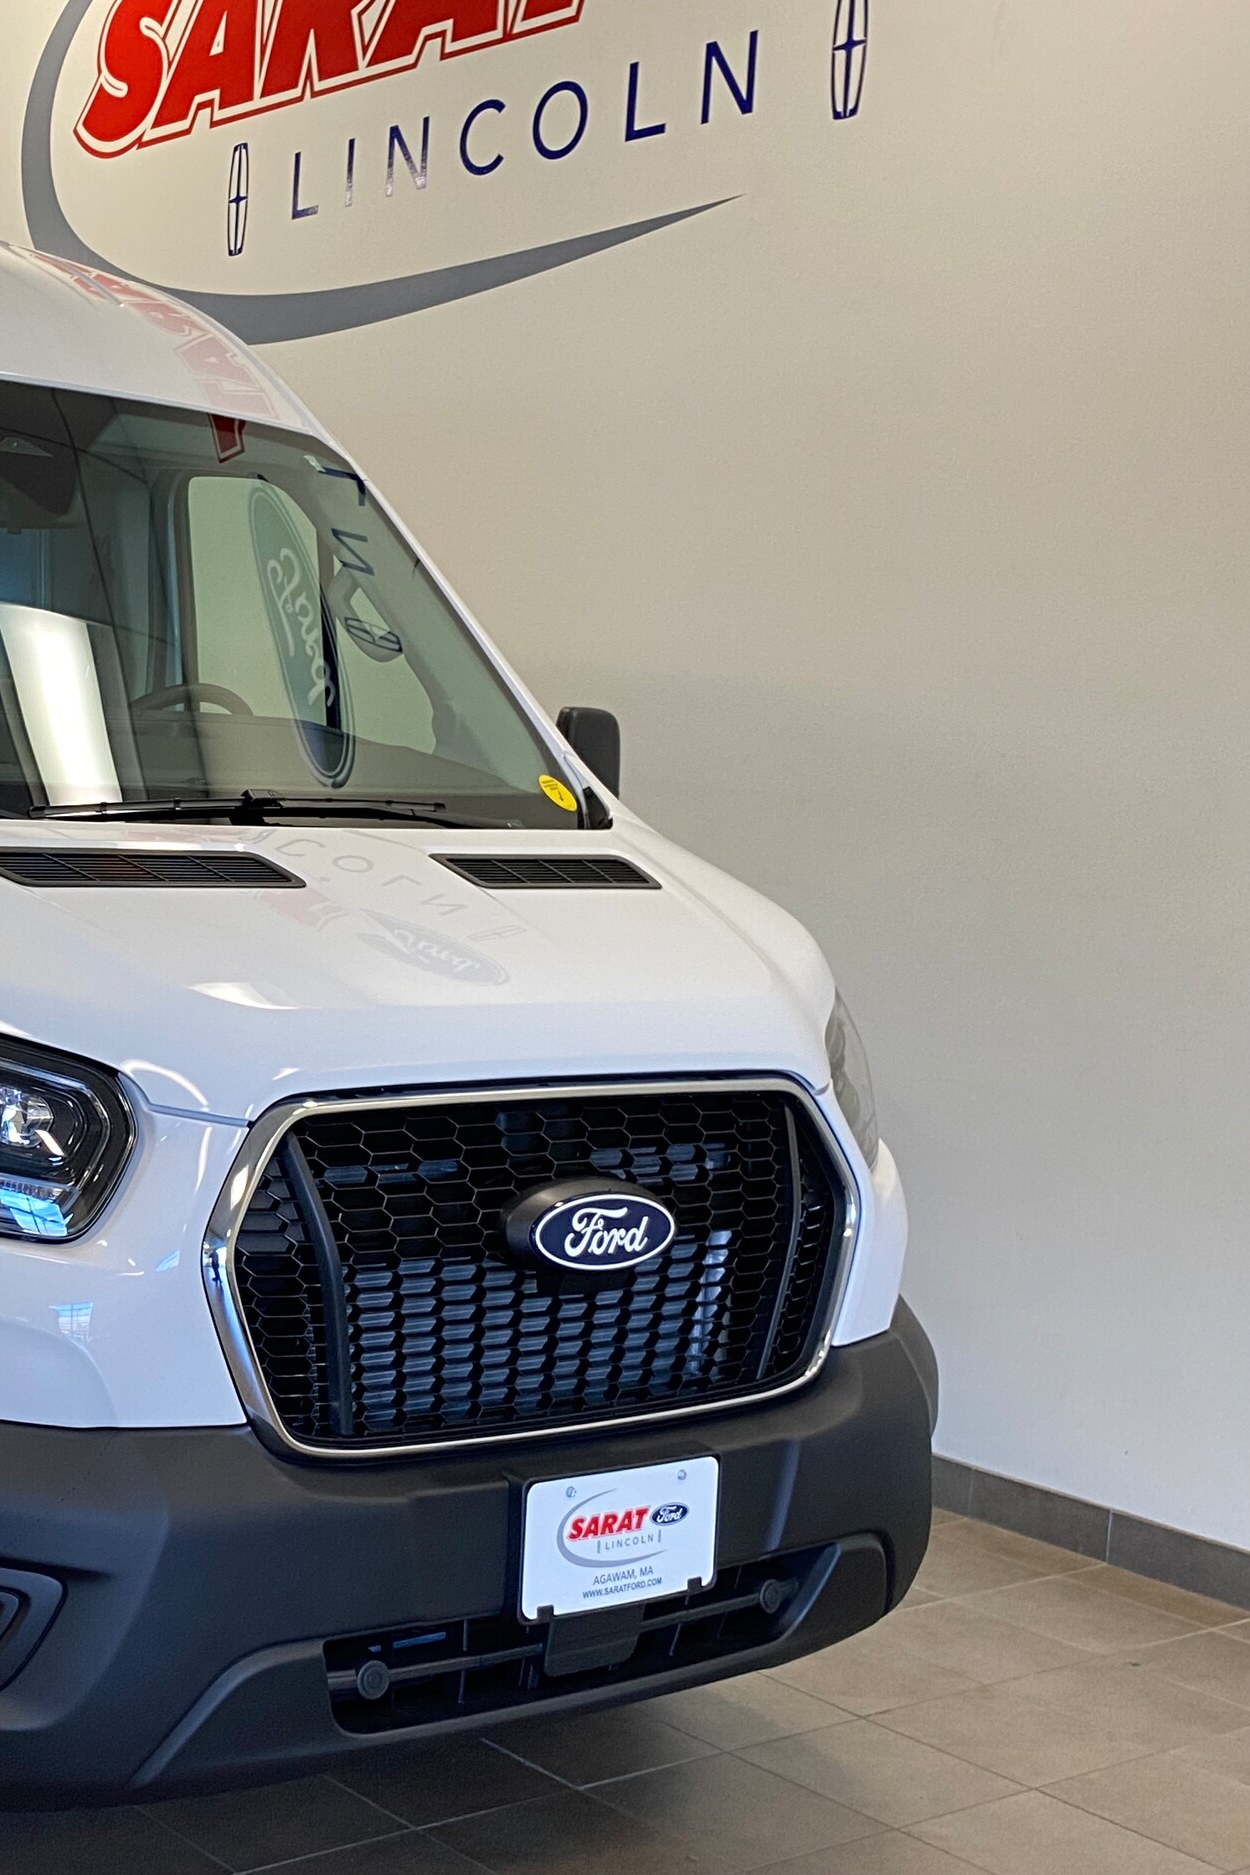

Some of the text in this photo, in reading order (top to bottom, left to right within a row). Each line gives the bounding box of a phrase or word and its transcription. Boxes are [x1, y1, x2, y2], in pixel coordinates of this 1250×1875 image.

[291, 29, 760, 221] LINCOLN
[563, 1206, 650, 1258] Ford
[566, 1504, 684, 1542] SARAT Ford
[604, 1533, 655, 1551] LINCOLN
[581, 1576, 663, 1599] WWW.SARATFORD.COM
[592, 1565, 655, 1586] AGAWAM, MA
